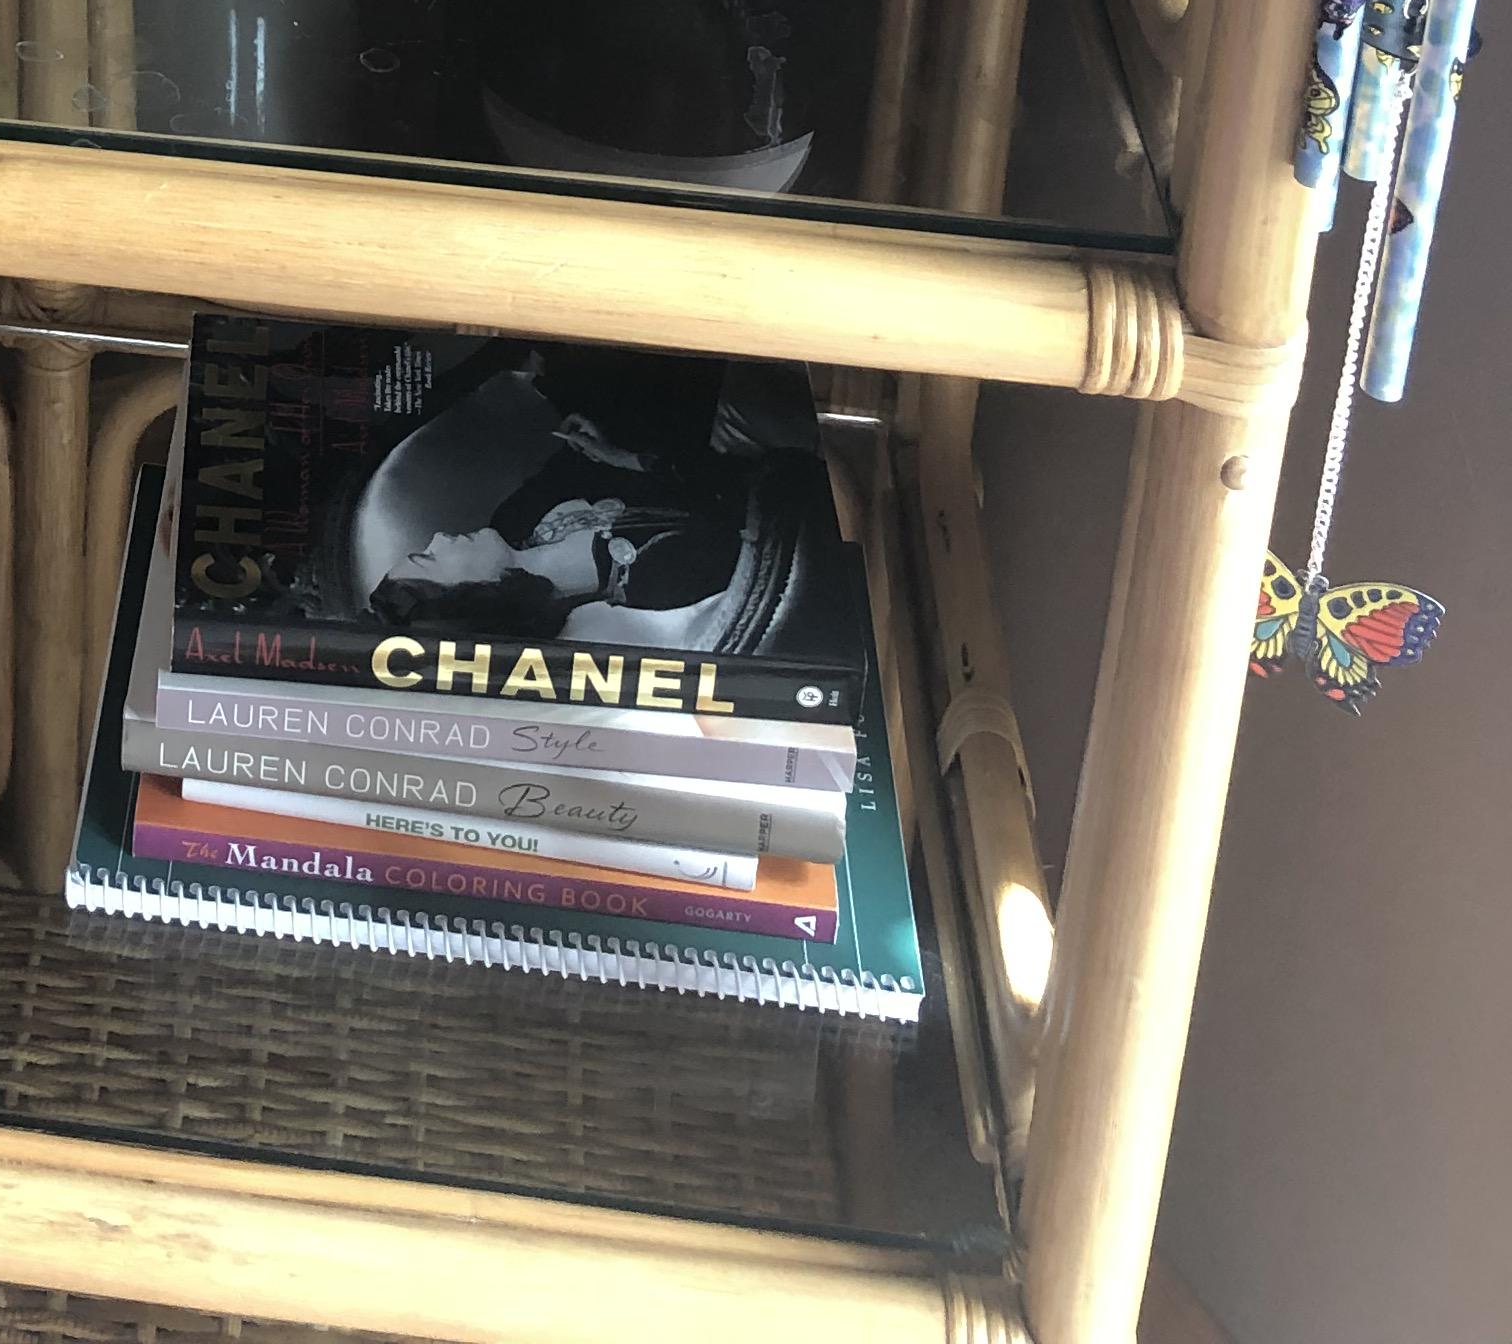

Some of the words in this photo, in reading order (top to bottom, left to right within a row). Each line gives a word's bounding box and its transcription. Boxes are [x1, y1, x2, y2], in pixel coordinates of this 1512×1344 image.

[190, 325, 269, 600] CHANEL
[185, 627, 241, 665] Axel
[255, 631, 361, 674] Madsen
[370, 634, 736, 714] CHANEL
[188, 699, 329, 736] LAUREN
[346, 713, 491, 750] CONRAD
[511, 724, 605, 764] Style
[158, 741, 306, 786] LAUREN
[324, 765, 478, 810] CONRAD
[498, 783, 640, 831] Beauty
[857, 755, 876, 812] LISA
[365, 812, 445, 838] HERE'S
[449, 823, 482, 843] TO
[486, 832, 540, 853] YOU!
[180, 840, 219, 861] The
[224, 842, 375, 883] Mandala
[384, 864, 548, 905] COLORING
[560, 888, 650, 917] BOOK
[683, 904, 754, 924] GOGARTY
